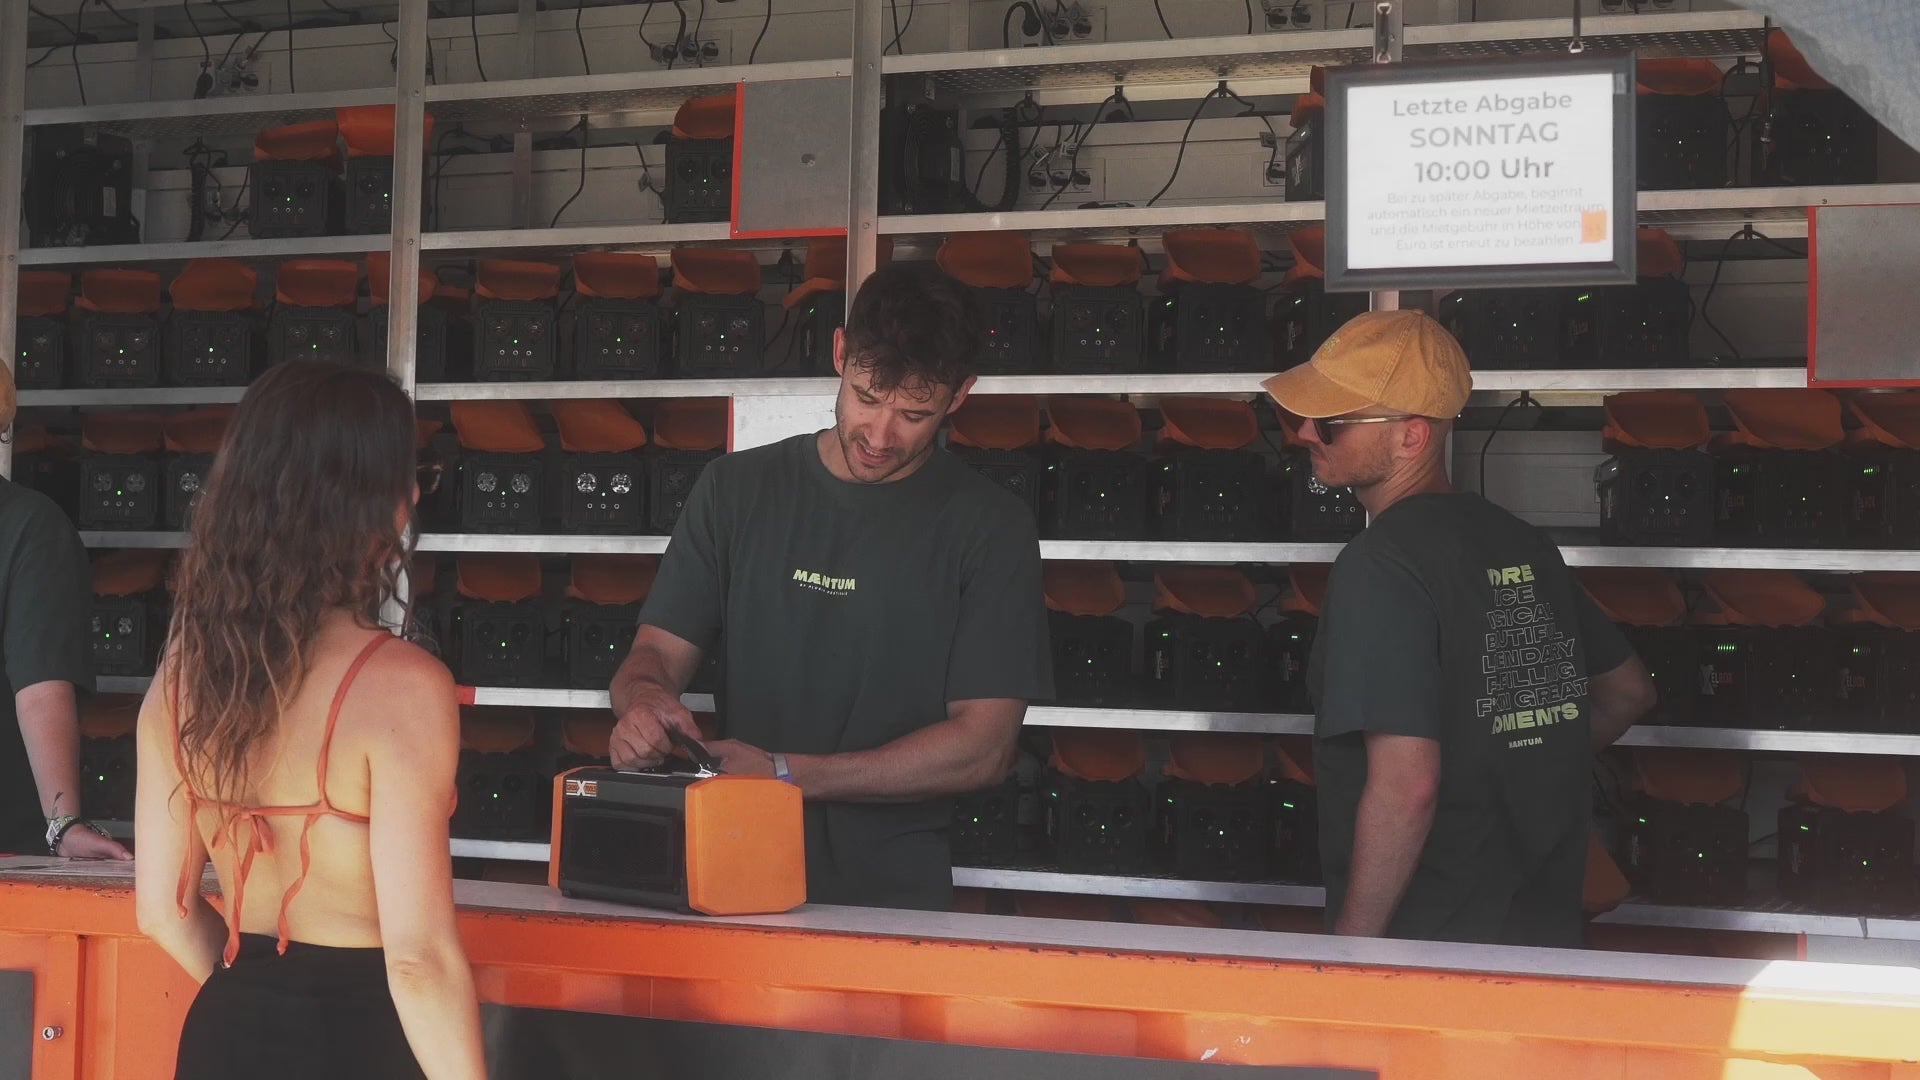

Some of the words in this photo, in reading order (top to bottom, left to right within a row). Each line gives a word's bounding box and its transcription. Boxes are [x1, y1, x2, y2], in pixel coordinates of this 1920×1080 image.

[1393, 98, 1468, 117] Letzte
[1476, 91, 1573, 115] Abgabe
[1409, 121, 1559, 148] SONNTAG
[1414, 159, 1490, 183] 10:00
[1501, 157, 1555, 179] Uhr
[1387, 192, 1408, 204] Bei
[1409, 194, 1426, 204] zu
[1429, 191, 1469, 205] später
[1531, 186, 1584, 202] beginnt
[1368, 206, 1448, 220] automatisch
[1450, 207, 1471, 217] ein
[1474, 206, 1512, 217] neuer
[1370, 223, 1396, 236] und
[1399, 222, 1419, 235] die
[1502, 220, 1514, 231] in
[1518, 218, 1554, 231] Höhe
[1556, 219, 1581, 230] von
[1396, 239, 1427, 251] Euro
[1430, 239, 1444, 250] ist
[1447, 237, 1491, 249] erneut
[1494, 237, 1510, 248] zu
[1514, 233, 1574, 248] bezahlen
[1514, 676, 1589, 708] GREAT
